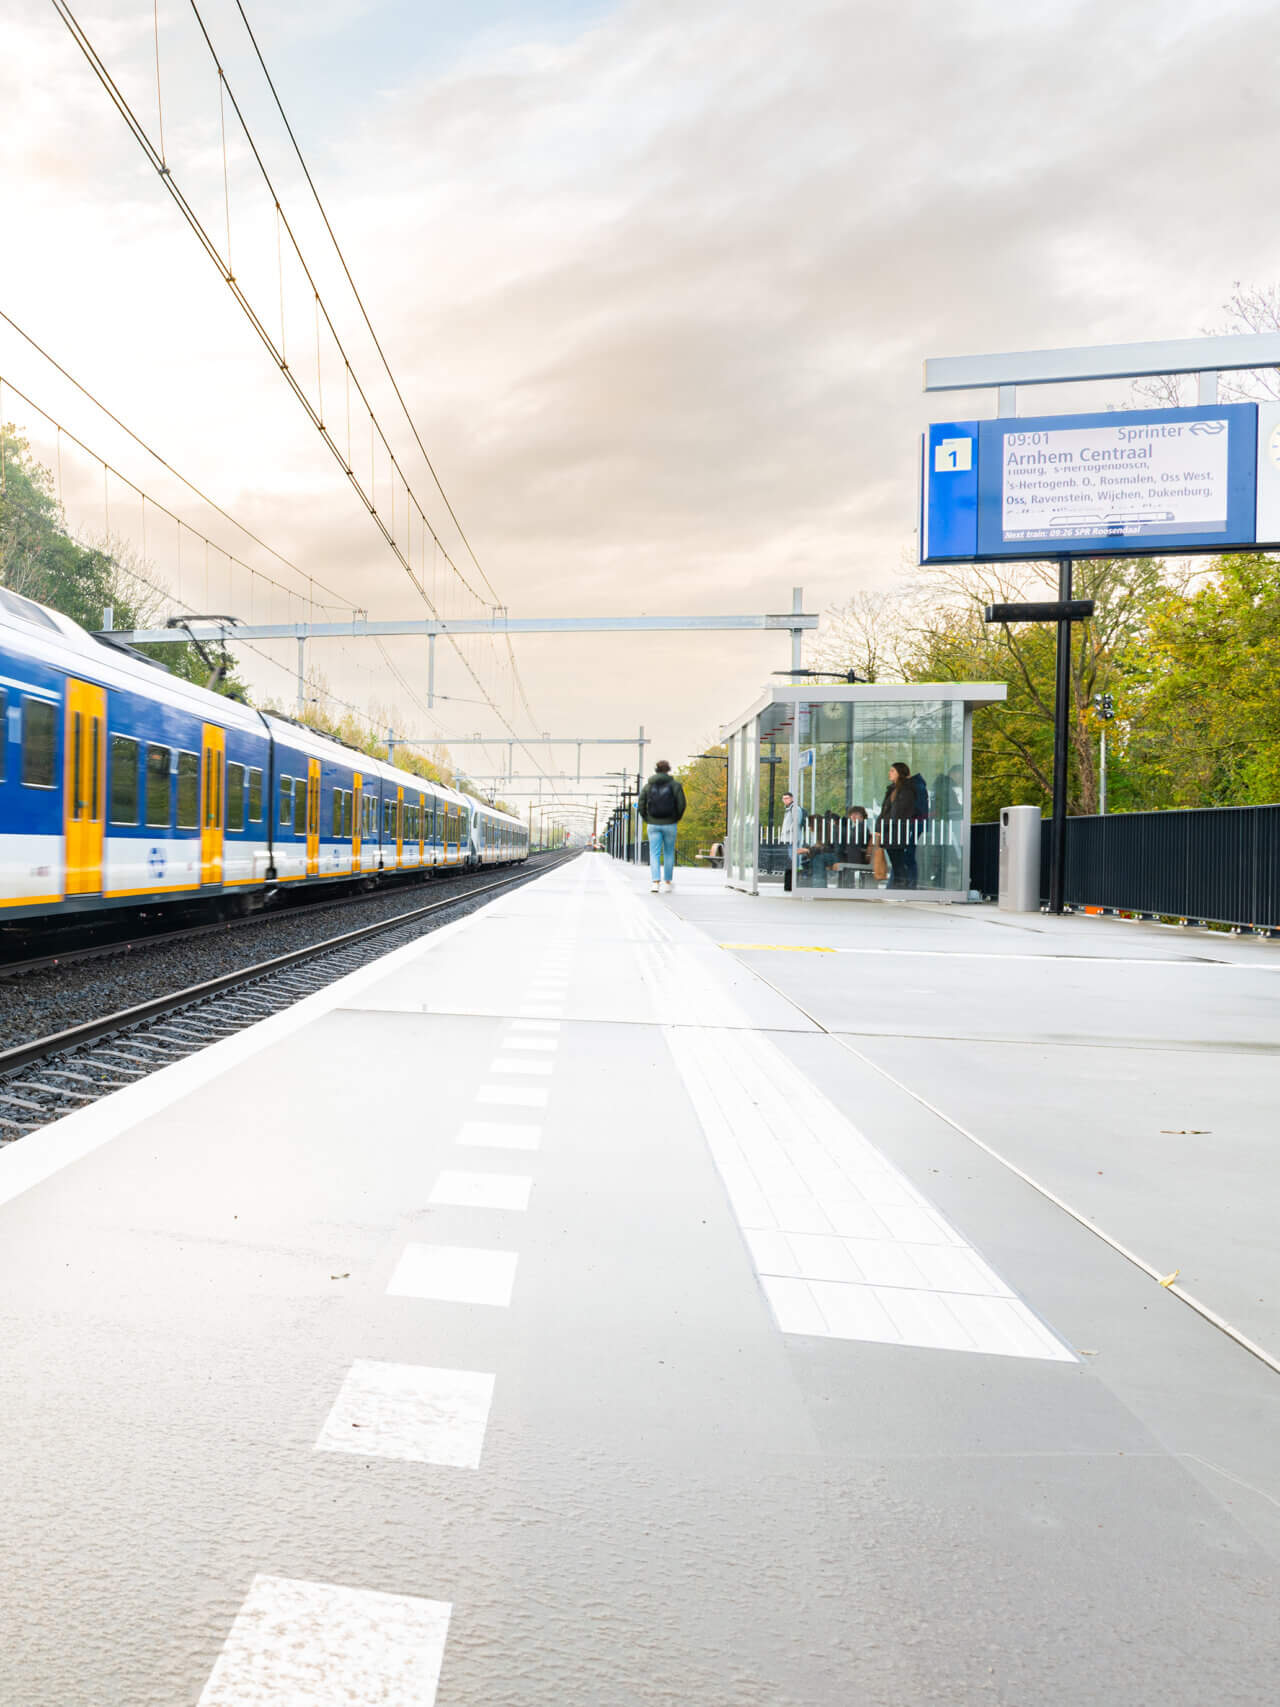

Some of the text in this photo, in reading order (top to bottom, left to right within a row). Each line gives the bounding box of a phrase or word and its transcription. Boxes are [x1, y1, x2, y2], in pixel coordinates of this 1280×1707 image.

[1008, 425, 1184, 446] 09:01 Sprinter
[948, 450, 957, 468] 1
[1008, 443, 1153, 466] Arnhem Centraal
[1100, 473, 1157, 486] Rosmalen,
[1161, 472, 1180, 482] Oss
[1007, 487, 1214, 506] Oss, Ravenstein, Wijchen, Dukenburg,
[1074, 527, 1091, 536] SPR
